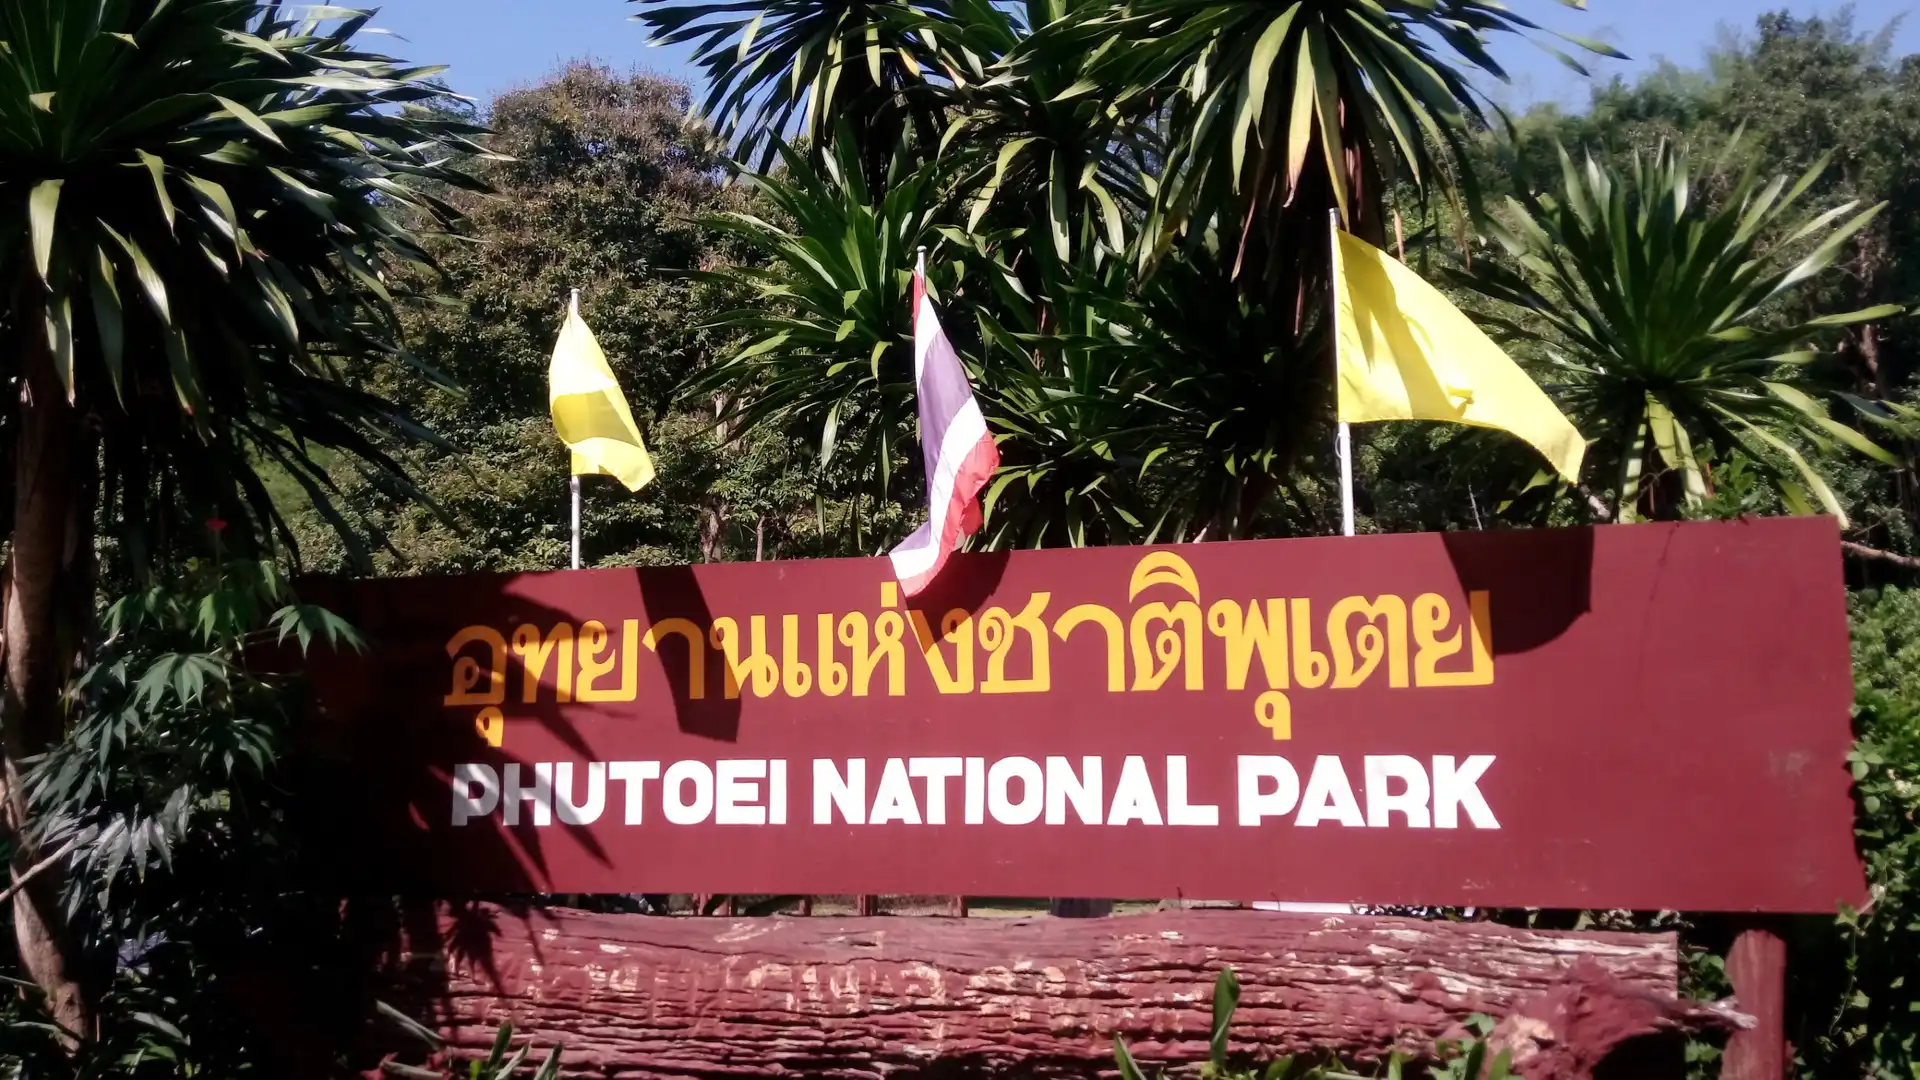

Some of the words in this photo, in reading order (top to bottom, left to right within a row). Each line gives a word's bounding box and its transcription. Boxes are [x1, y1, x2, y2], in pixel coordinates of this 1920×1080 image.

[444, 551, 1495, 747] อุทยานแห่งชาติพุเตย
[451, 759, 787, 827] PHUTOEI
[813, 755, 1220, 826] NATIONAL
[1238, 754, 1501, 830] PARK
